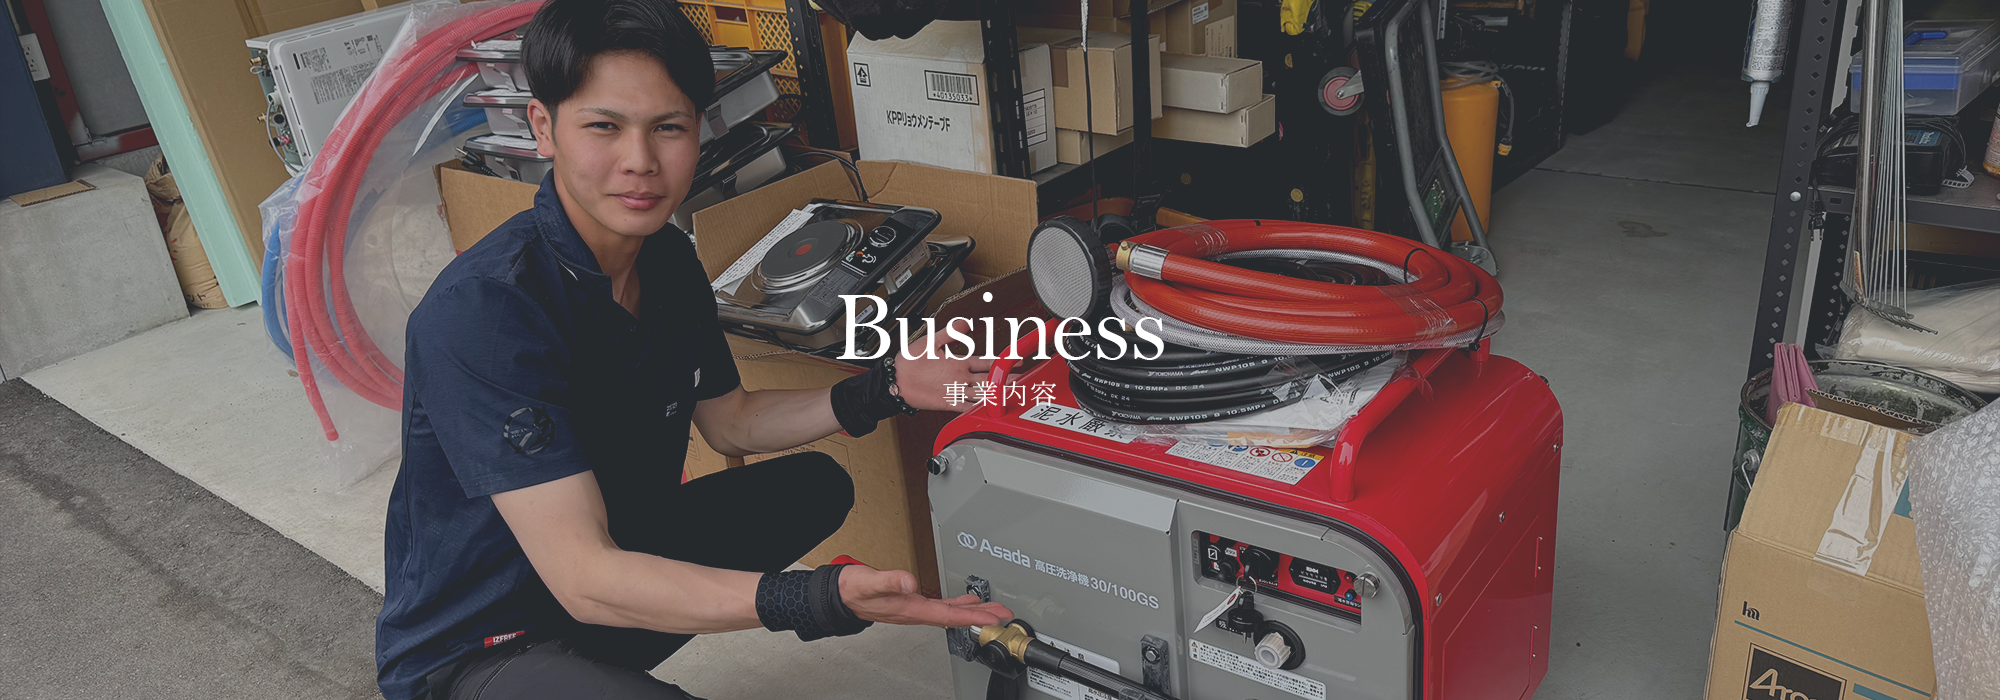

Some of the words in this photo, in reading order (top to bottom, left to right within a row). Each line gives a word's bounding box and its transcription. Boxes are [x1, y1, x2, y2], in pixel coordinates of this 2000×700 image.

[1215, 361, 1256, 373] NWP105
[1169, 413, 1208, 421] NWP105
[1226, 404, 1266, 415] 10.5MPa
[979, 538, 1031, 568] Asada
